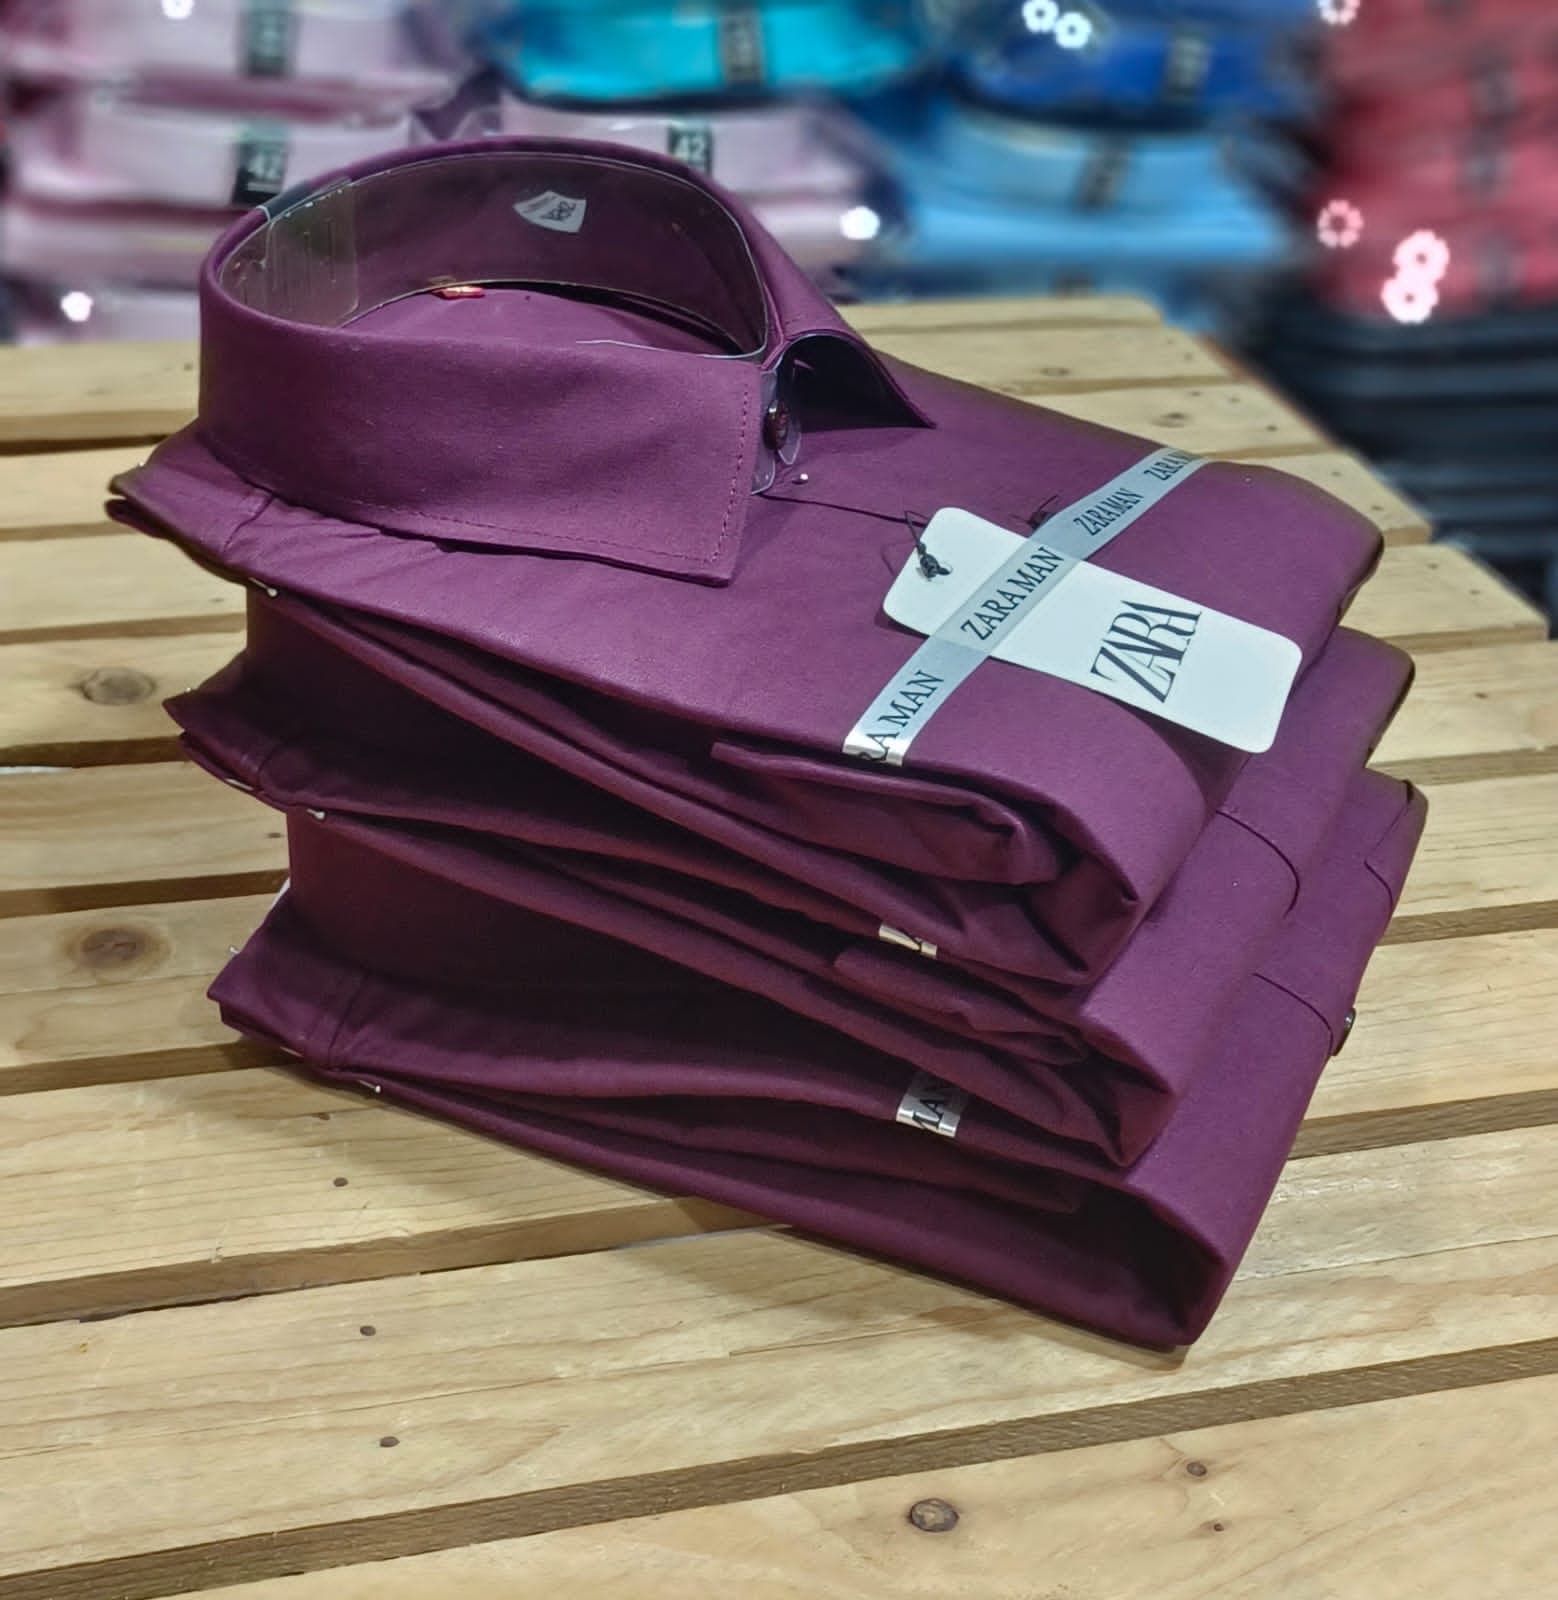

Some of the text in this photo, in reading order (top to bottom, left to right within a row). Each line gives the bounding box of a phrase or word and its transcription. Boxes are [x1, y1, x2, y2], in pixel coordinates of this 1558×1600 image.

[960, 546, 1065, 641] ZARA MAN
[877, 669, 945, 728] MAN
[1090, 599, 1202, 703] ZARA
